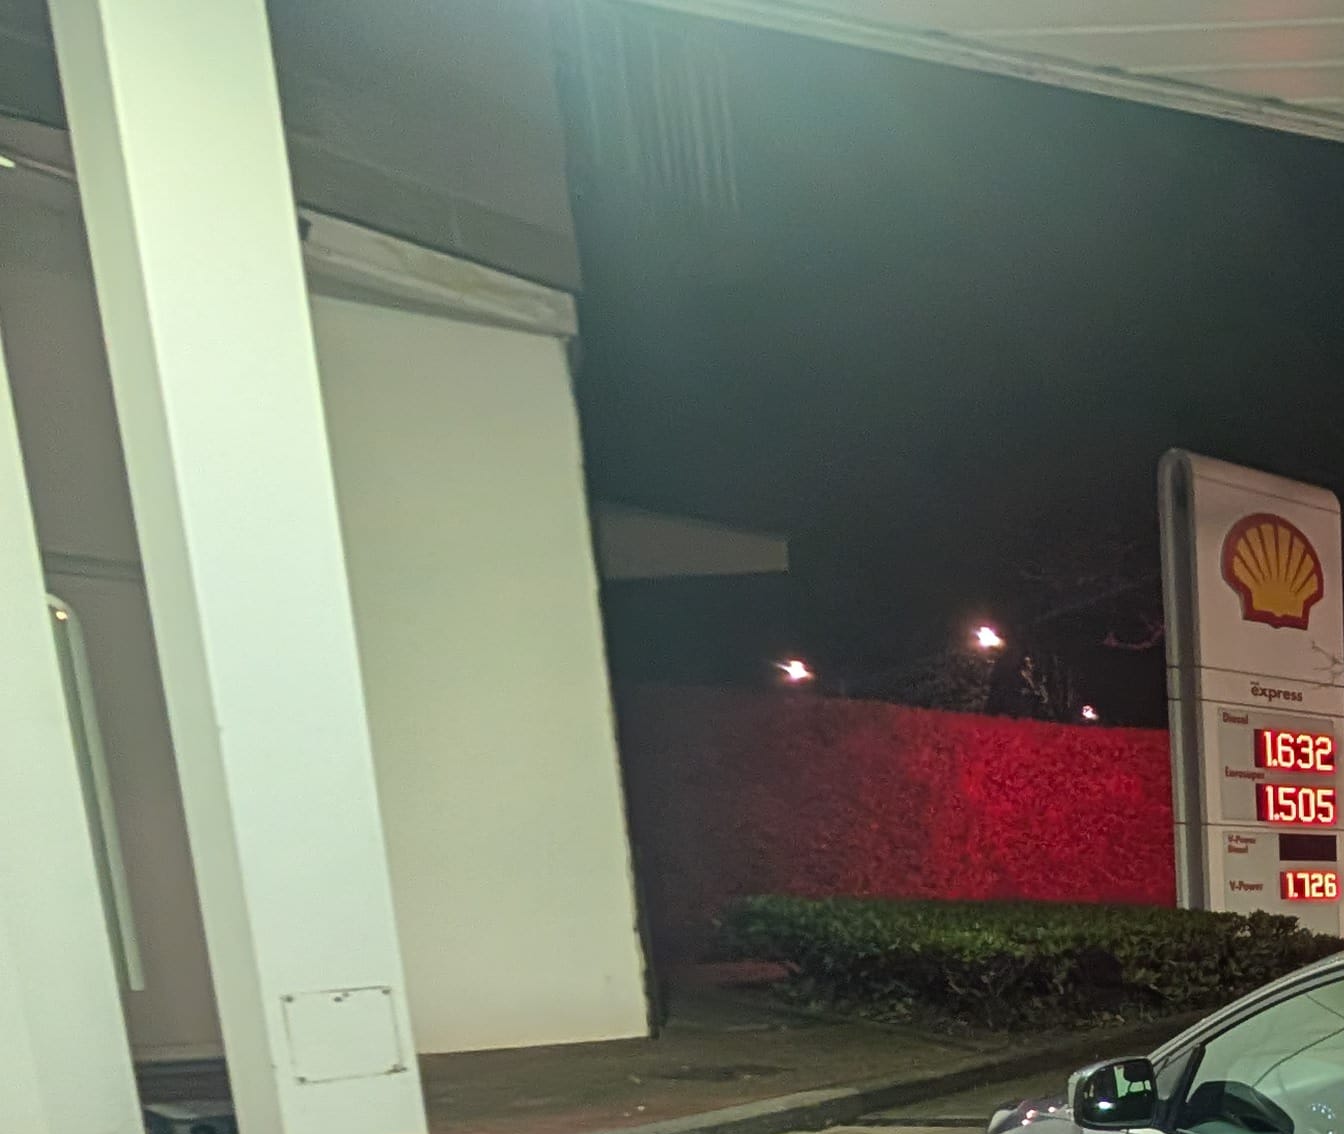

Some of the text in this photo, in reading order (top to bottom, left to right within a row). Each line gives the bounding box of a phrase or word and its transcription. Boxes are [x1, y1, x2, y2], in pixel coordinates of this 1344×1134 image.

[1251, 685, 1303, 701] express
[1263, 731, 1333, 771] 1.632
[1265, 785, 1334, 823] 1.505
[1286, 872, 1337, 898] 1.726
